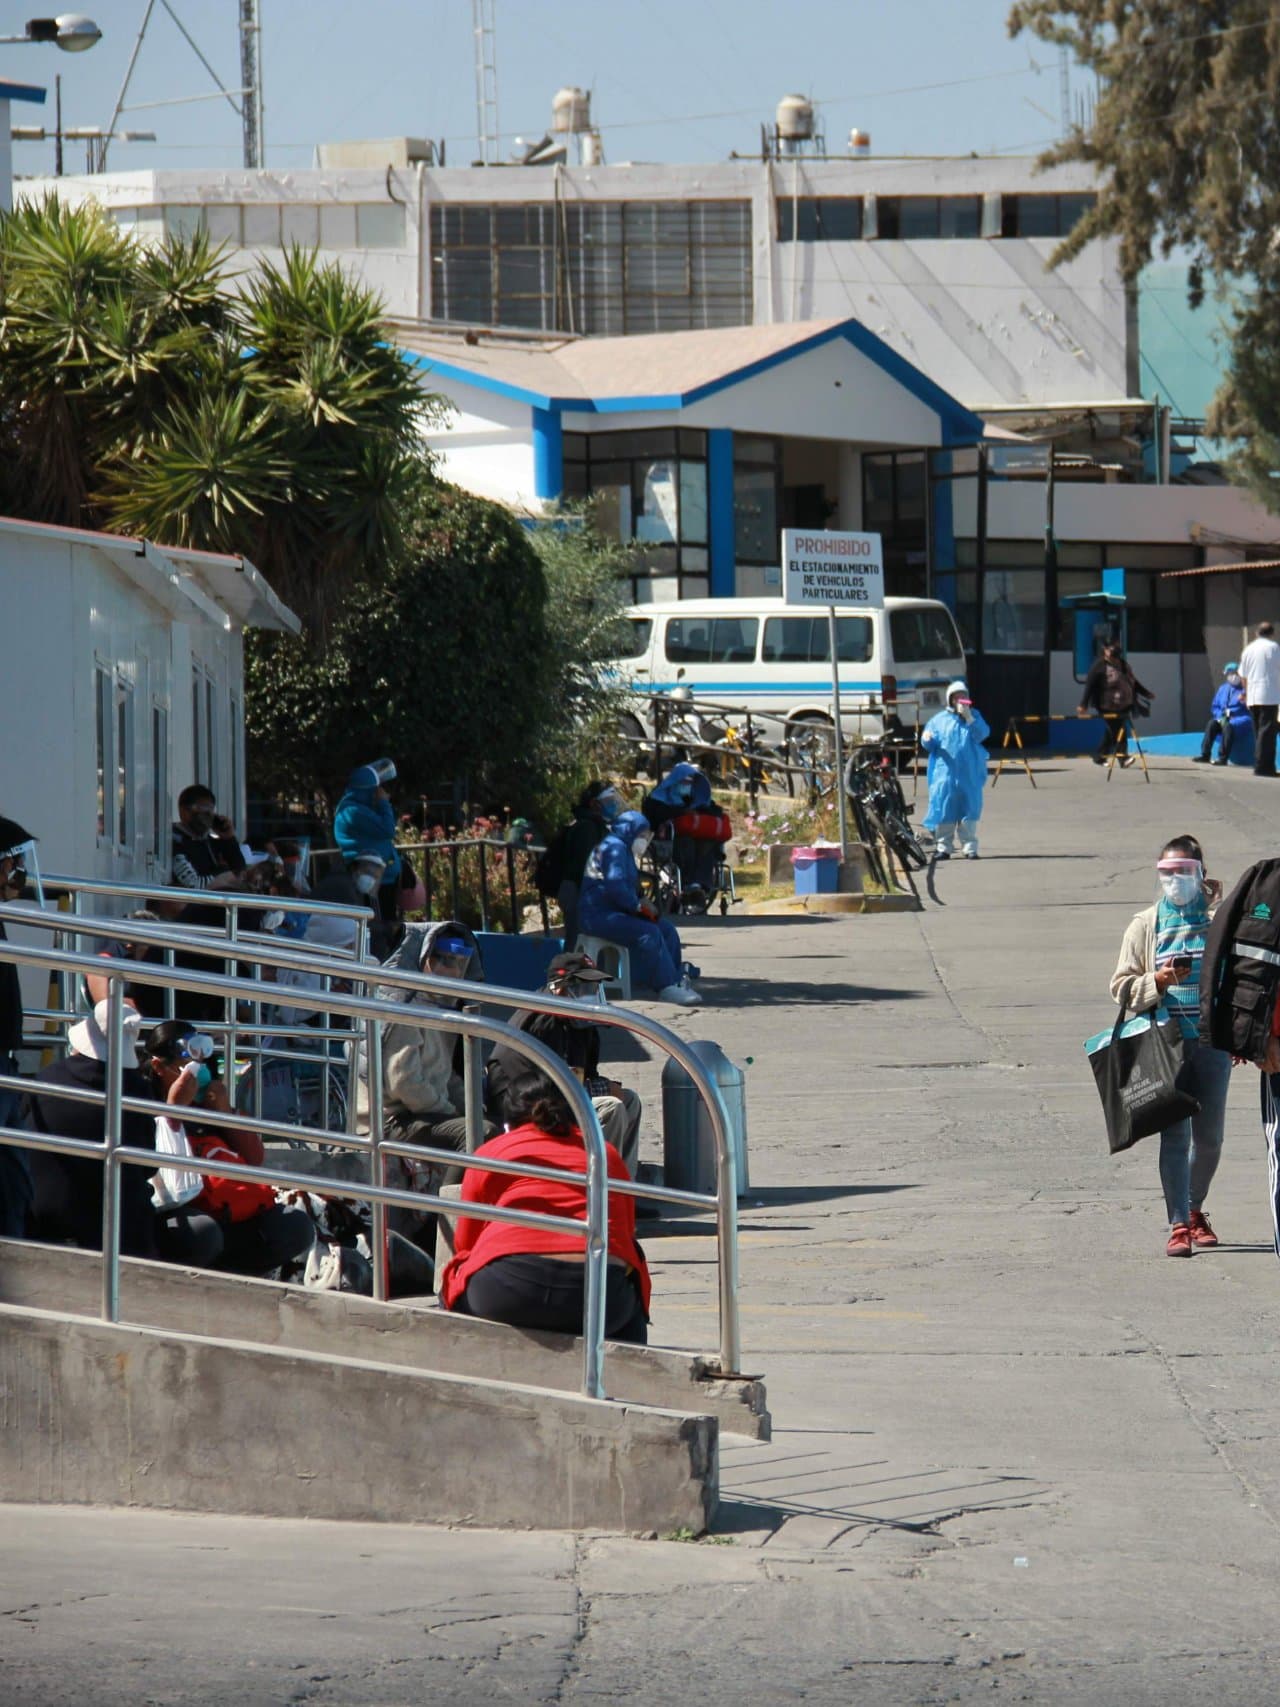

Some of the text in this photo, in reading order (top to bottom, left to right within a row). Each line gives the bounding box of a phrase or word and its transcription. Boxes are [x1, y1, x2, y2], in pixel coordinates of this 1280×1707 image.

[795, 537, 871, 556] PROHIBIDO
[789, 560, 879, 575] EL ESTACIONAMIENTO
[803, 574, 865, 588] DE VEHICULOS
[802, 587, 869, 601] PARTICULARES
